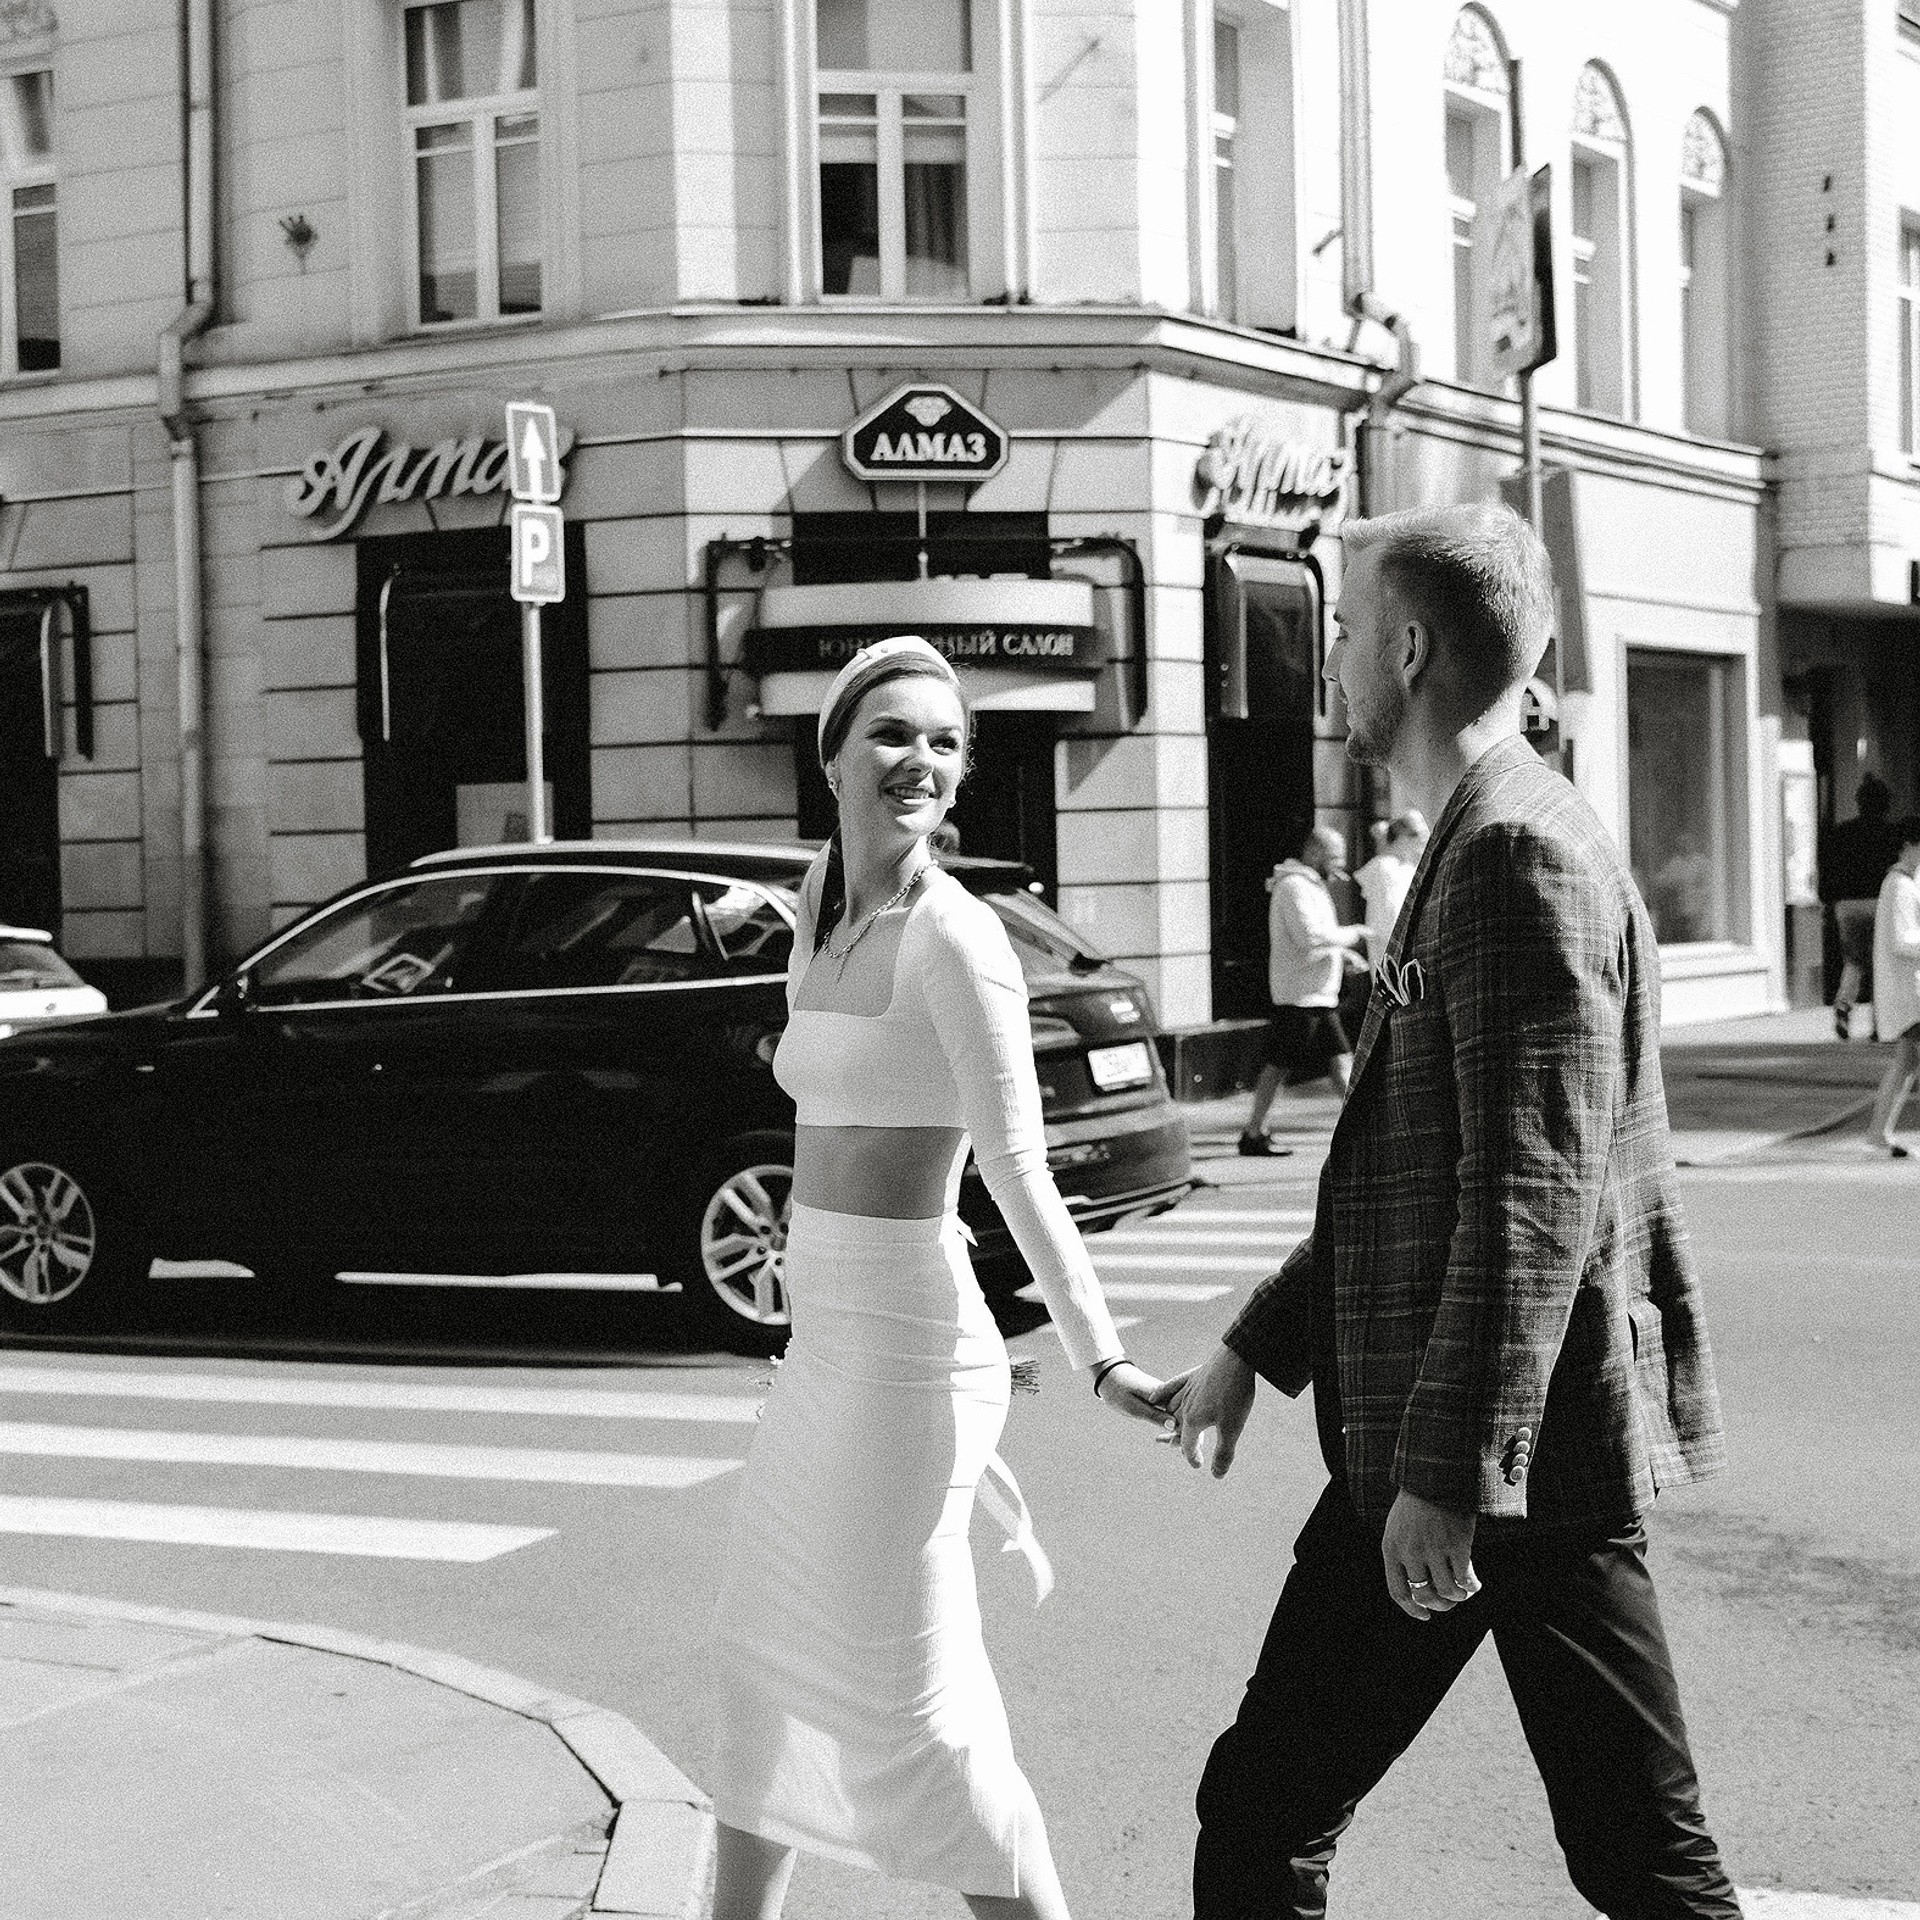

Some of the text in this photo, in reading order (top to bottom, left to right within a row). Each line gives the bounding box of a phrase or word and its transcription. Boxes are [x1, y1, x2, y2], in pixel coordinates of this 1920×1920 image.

[870, 432, 987, 463] АЛМАЗ
[520, 519, 550, 587] P
[1002, 633, 1074, 657] САЛОН
